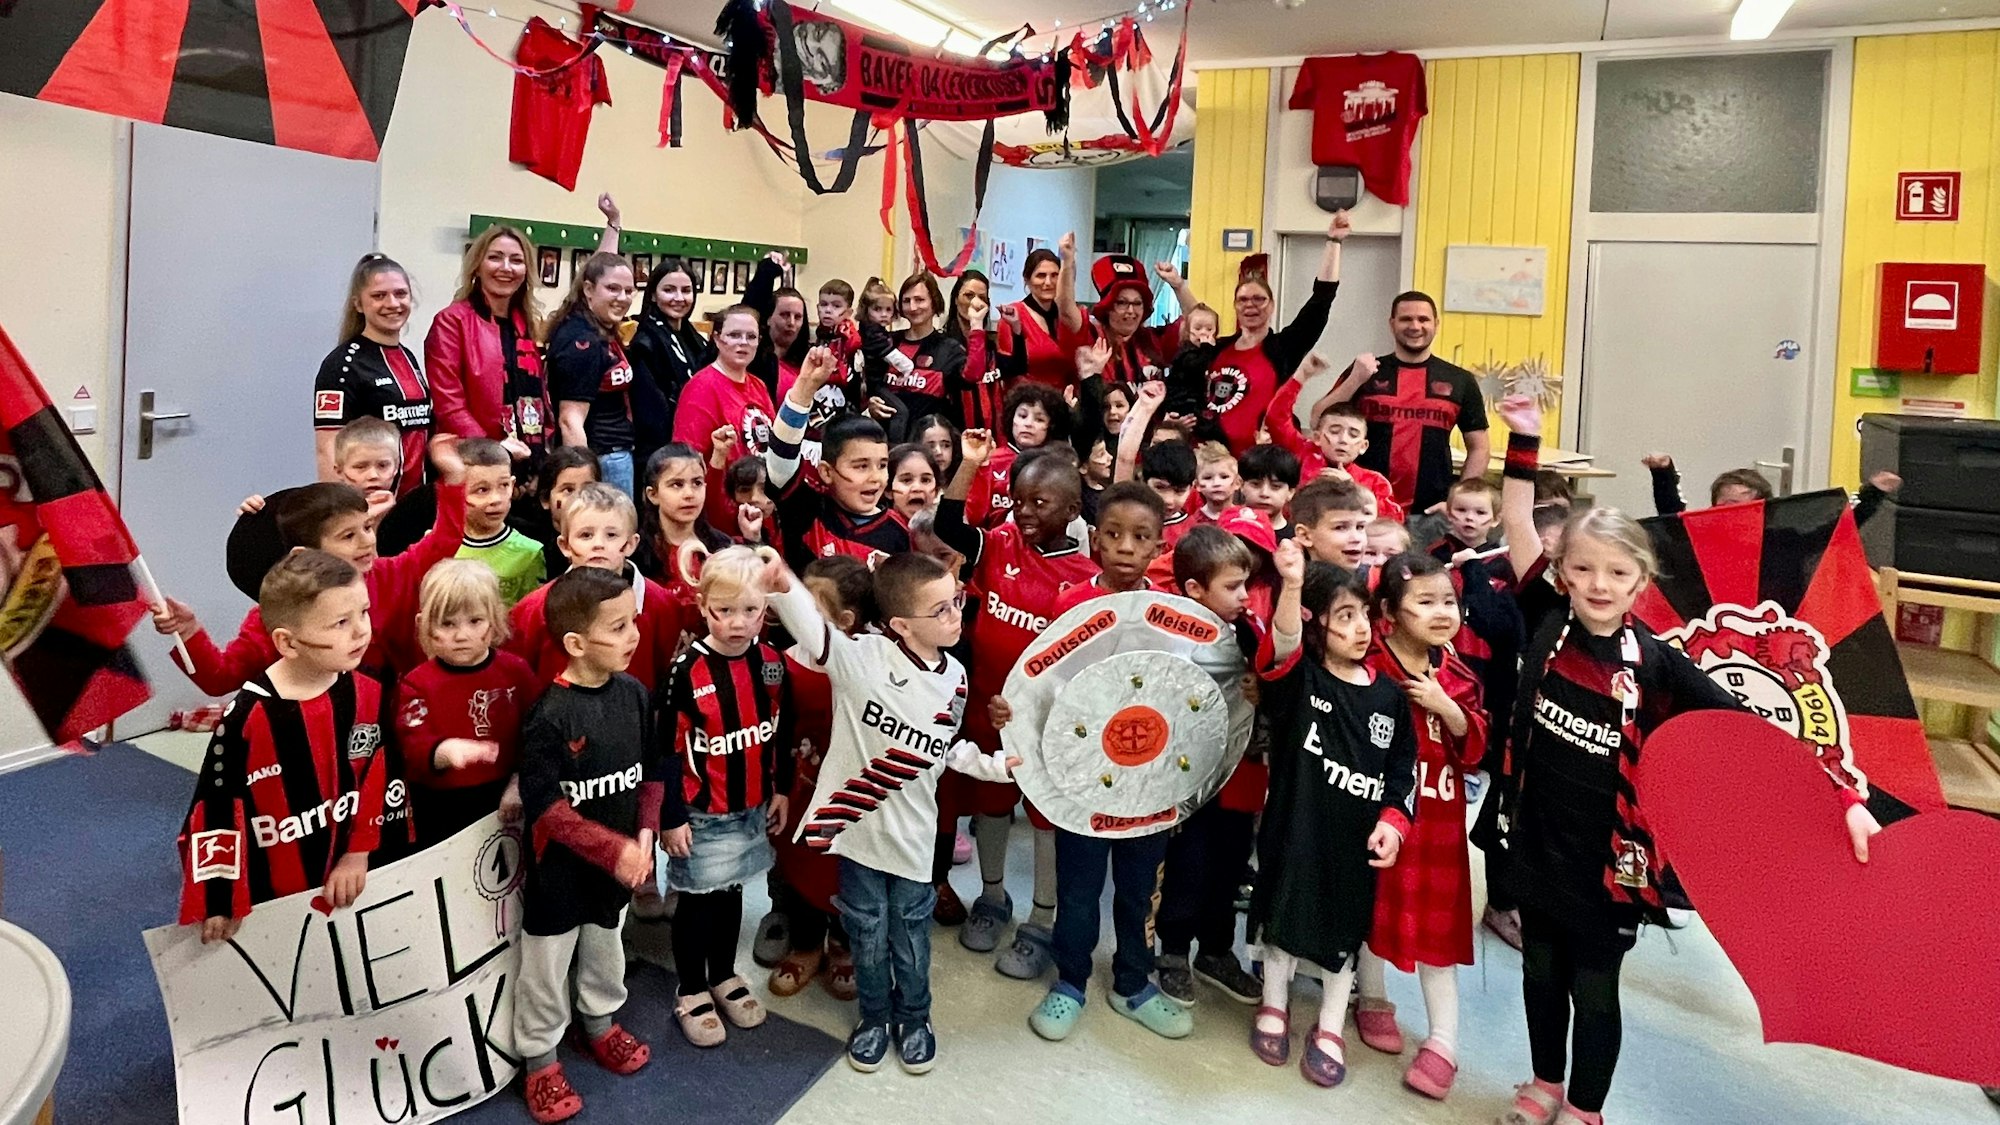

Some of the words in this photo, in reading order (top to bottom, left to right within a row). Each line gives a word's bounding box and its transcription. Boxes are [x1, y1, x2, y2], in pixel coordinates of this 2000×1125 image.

[921, 65, 940, 98] 04
[1028, 611, 1115, 677] Deutscher
[1148, 606, 1213, 640] Meister
[693, 683, 716, 699] JAKO
[1802, 688, 1830, 739] 1904
[246, 763, 282, 786] JAKO
[1420, 761, 1456, 801] LG
[227, 876, 511, 1023] VIEL
